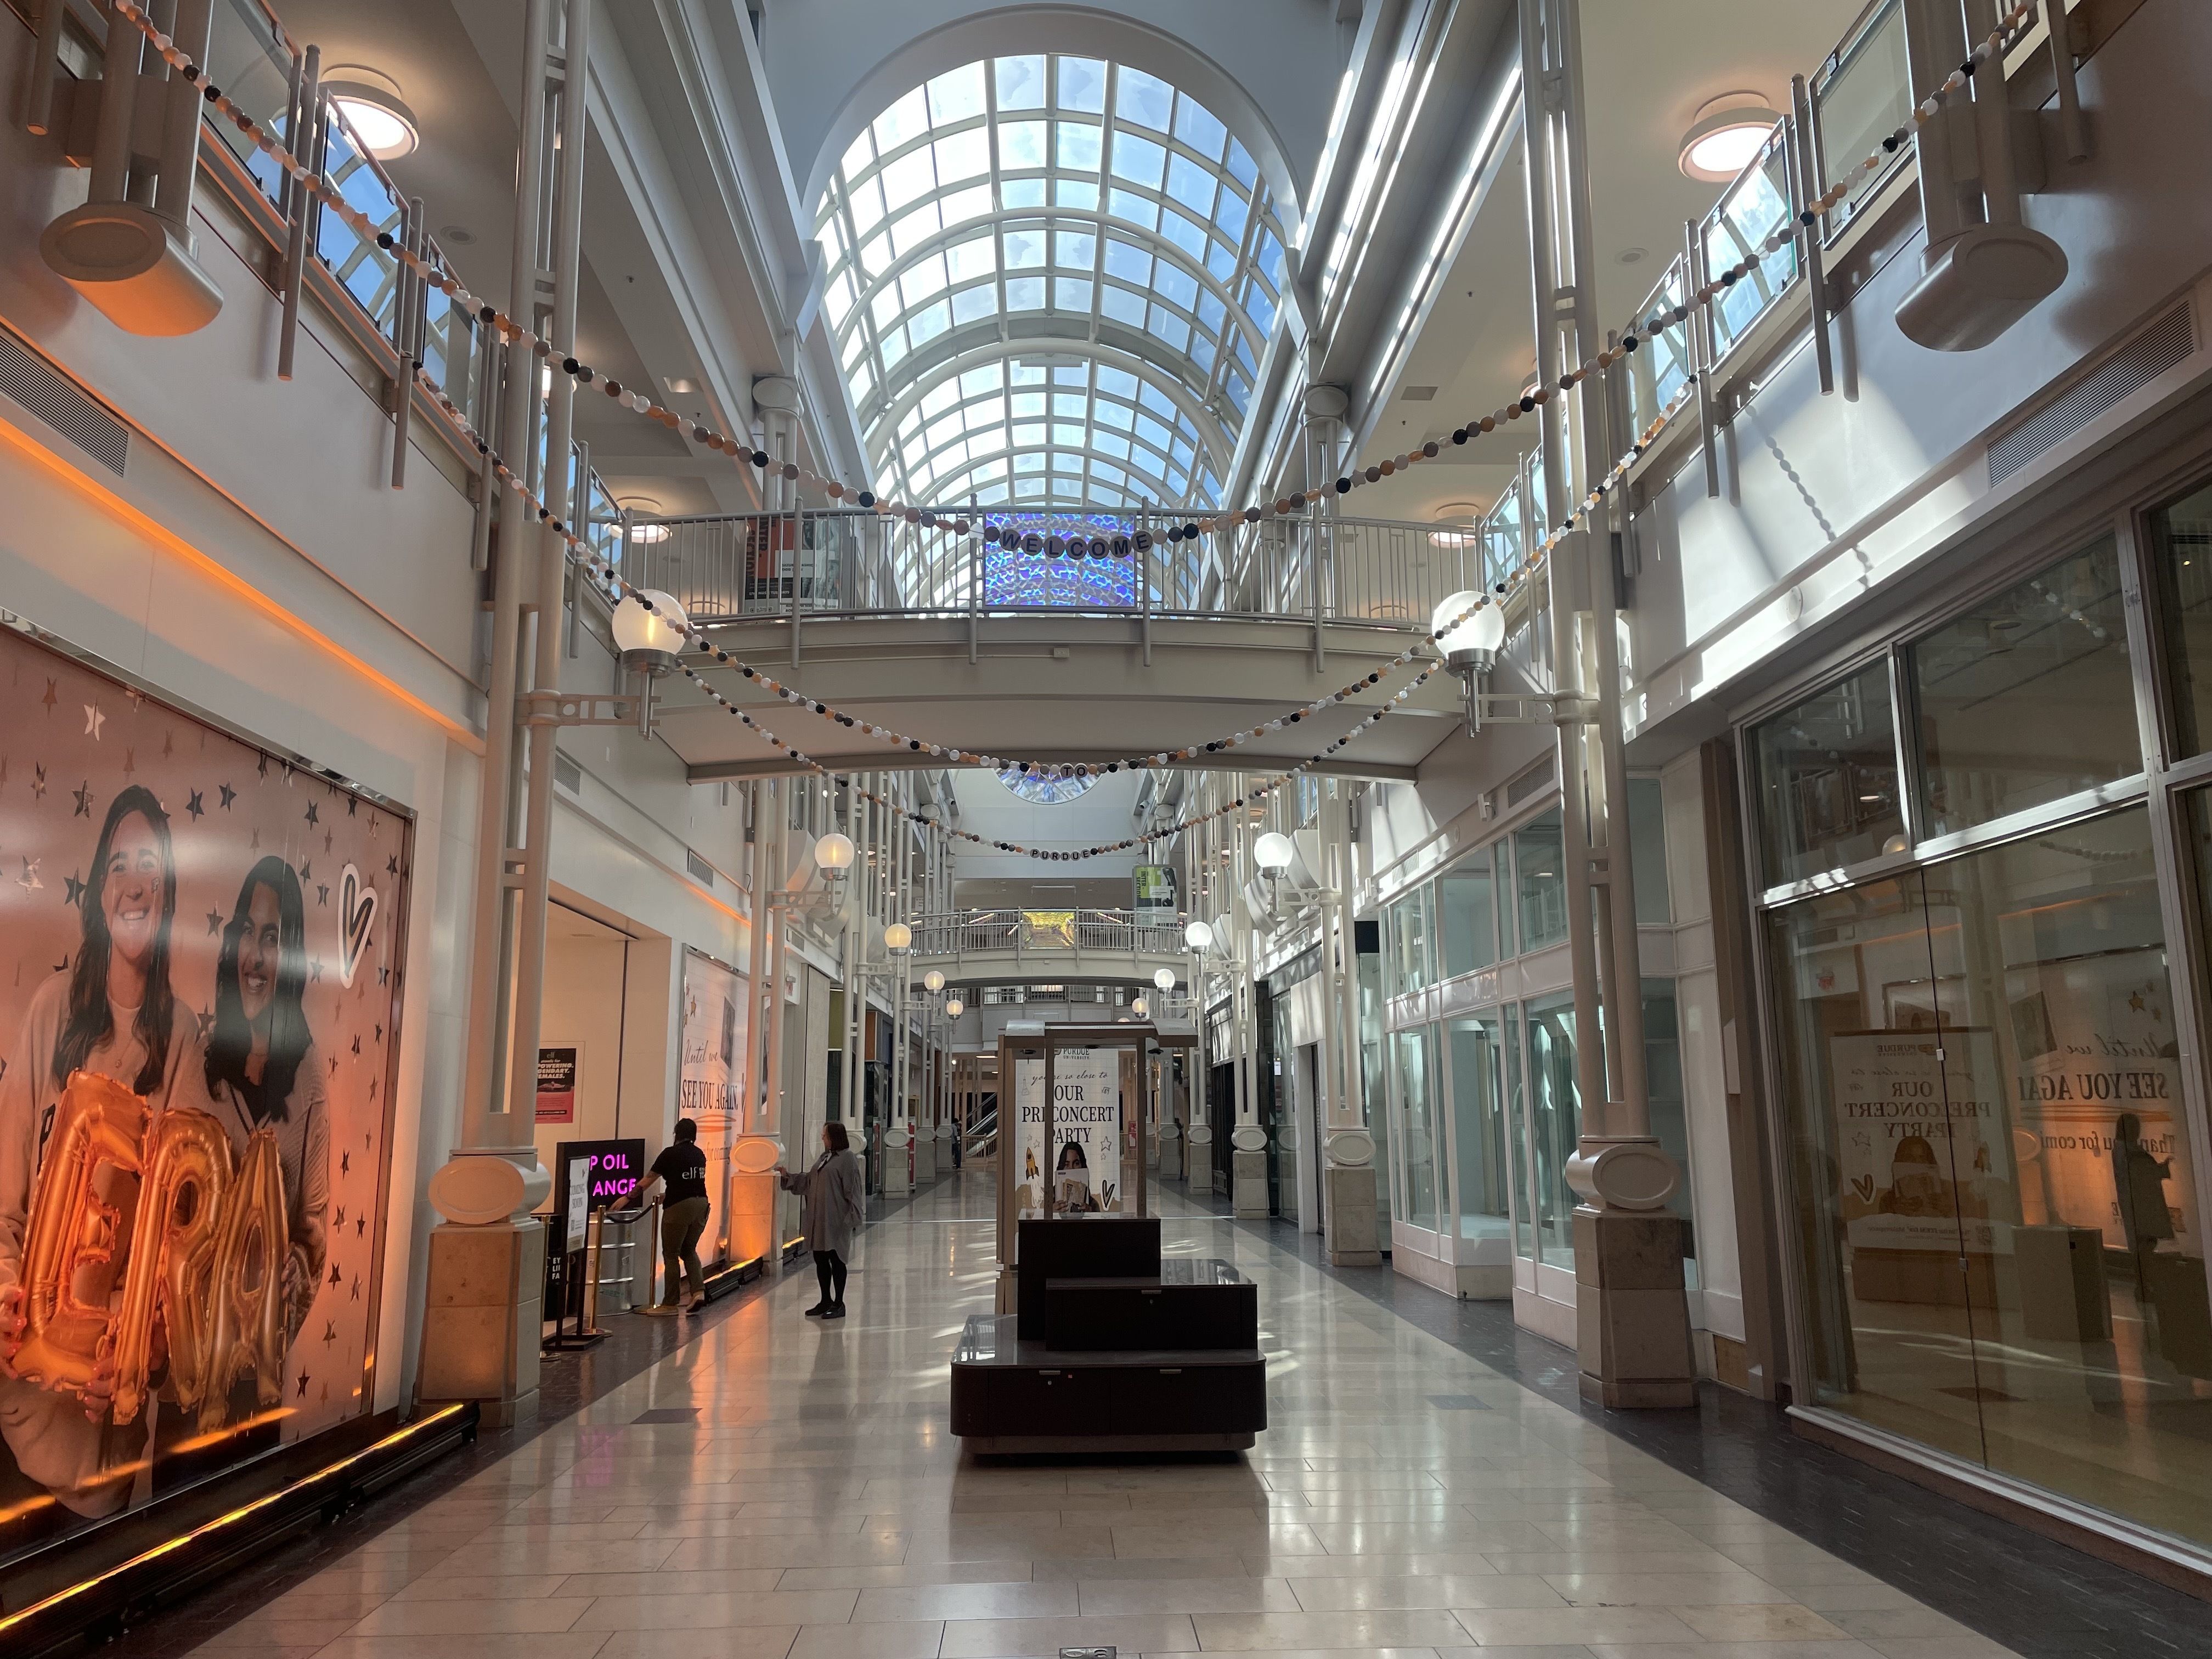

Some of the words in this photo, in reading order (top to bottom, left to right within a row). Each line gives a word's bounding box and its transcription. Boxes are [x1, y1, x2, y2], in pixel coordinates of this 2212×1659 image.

[1002, 533, 1150, 557] WELCOME
[1063, 767, 1086, 776] TO
[1031, 850, 1090, 861] PURDUE
[684, 1039, 709, 1066] Until
[709, 1052, 718, 1062] we
[1076, 1070, 1096, 1080] close
[681, 1079, 697, 1109] SEE
[698, 1081, 715, 1109] YOU
[715, 1083, 738, 1110] AGAIN.
[1054, 1085, 1085, 1101] OUR
[603, 1154, 629, 1170] OIL
[682, 1166, 698, 1180] elf
[9, 1068, 290, 1434] ERA
